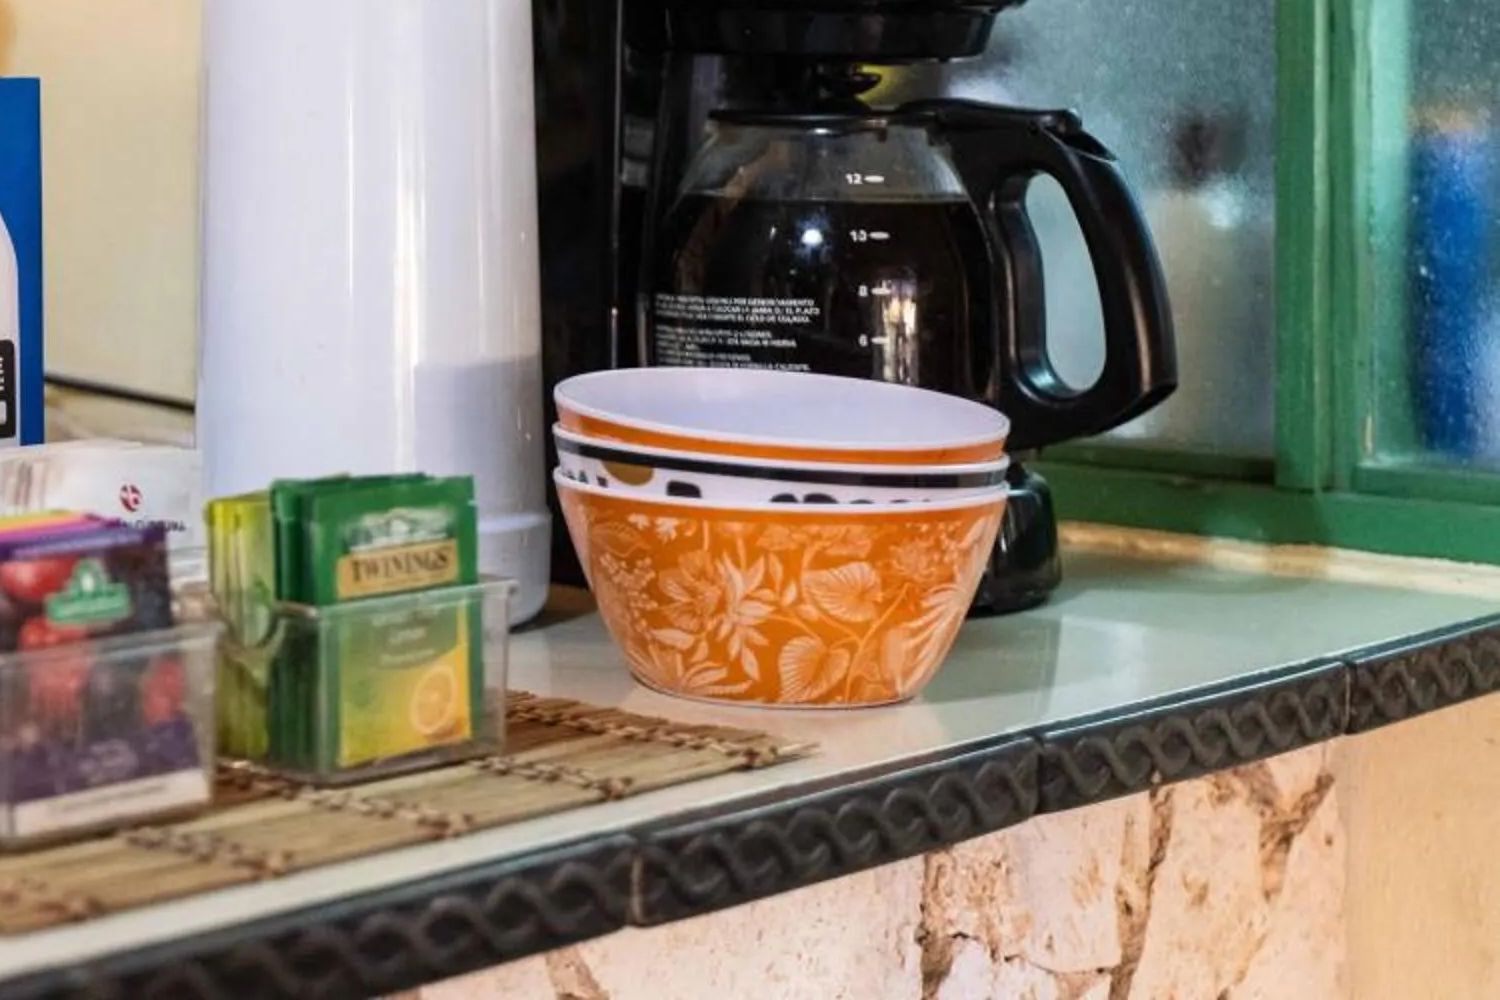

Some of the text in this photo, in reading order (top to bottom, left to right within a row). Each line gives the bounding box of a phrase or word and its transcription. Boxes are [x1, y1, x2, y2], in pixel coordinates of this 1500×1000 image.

[845, 173, 863, 185] 12
[850, 229, 868, 242] 10
[351, 546, 449, 583] TWININGS
